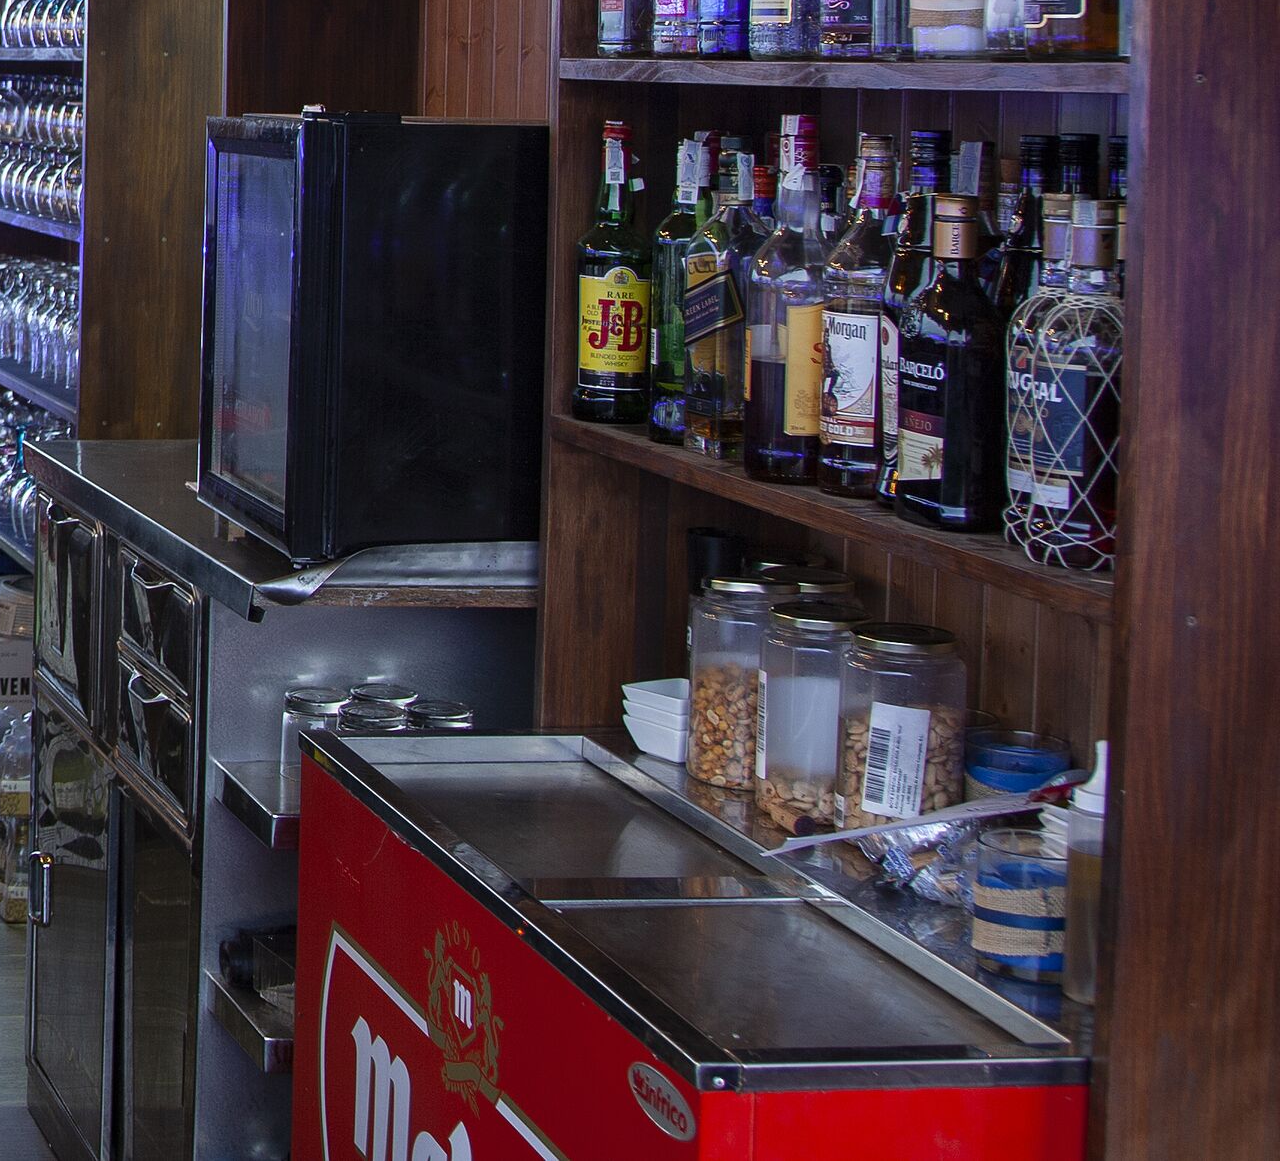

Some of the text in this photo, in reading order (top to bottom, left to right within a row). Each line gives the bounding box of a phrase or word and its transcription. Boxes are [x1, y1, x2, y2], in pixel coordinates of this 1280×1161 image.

[607, 291, 635, 299] RARE
[685, 303, 701, 317] REEN
[588, 298, 644, 353] J&B
[827, 316, 867, 341] Morgan
[590, 352, 617, 360] BLENDED
[899, 356, 945, 381] BARCELÓ
[829, 424, 853, 437] GOLD
[903, 415, 932, 431] AÑEJO
